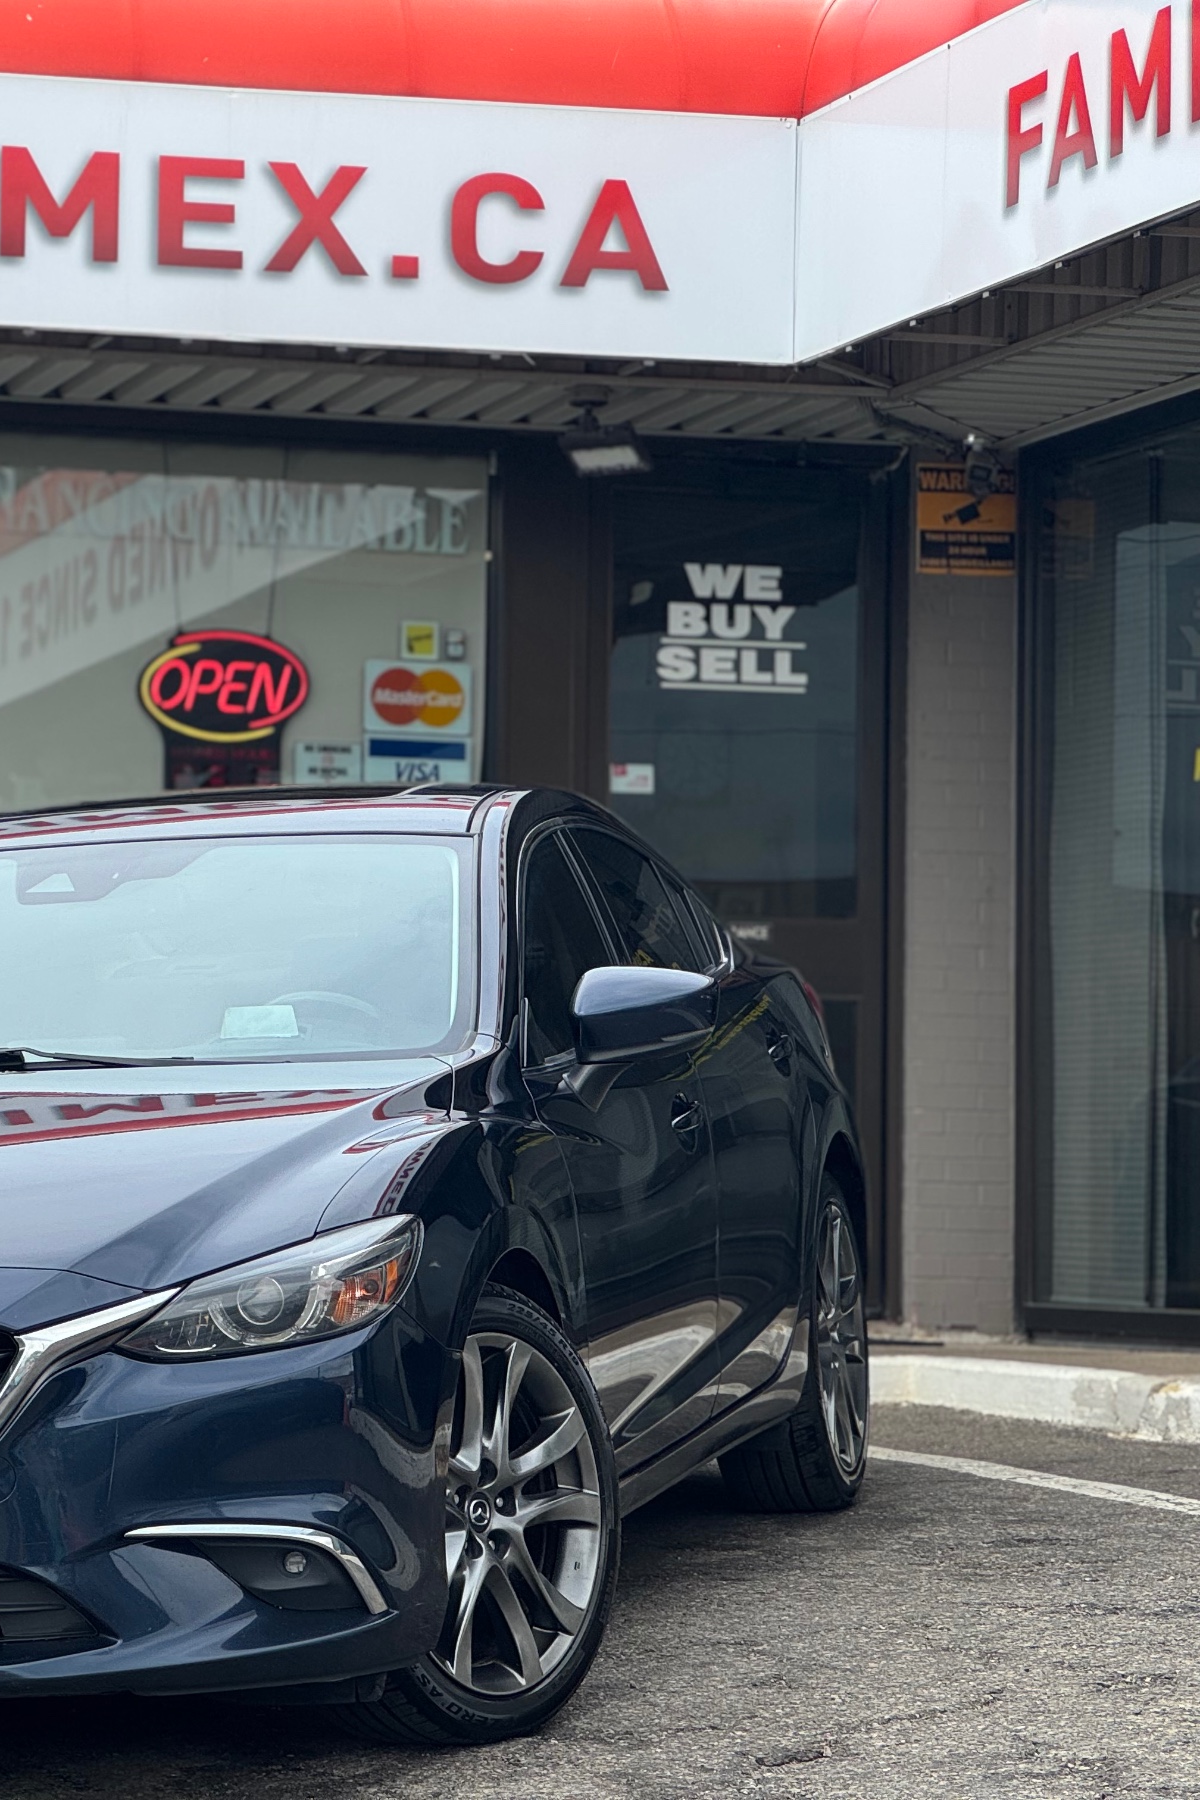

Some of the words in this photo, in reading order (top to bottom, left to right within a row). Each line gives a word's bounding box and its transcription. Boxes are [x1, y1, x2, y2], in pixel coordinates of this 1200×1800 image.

[684, 563, 782, 601] WE
[667, 601, 795, 640] BUY
[656, 646, 808, 685] SELL
[150, 659, 293, 714] OPEN
[374, 687, 463, 708] MasterCard
[395, 761, 440, 781] VISA
